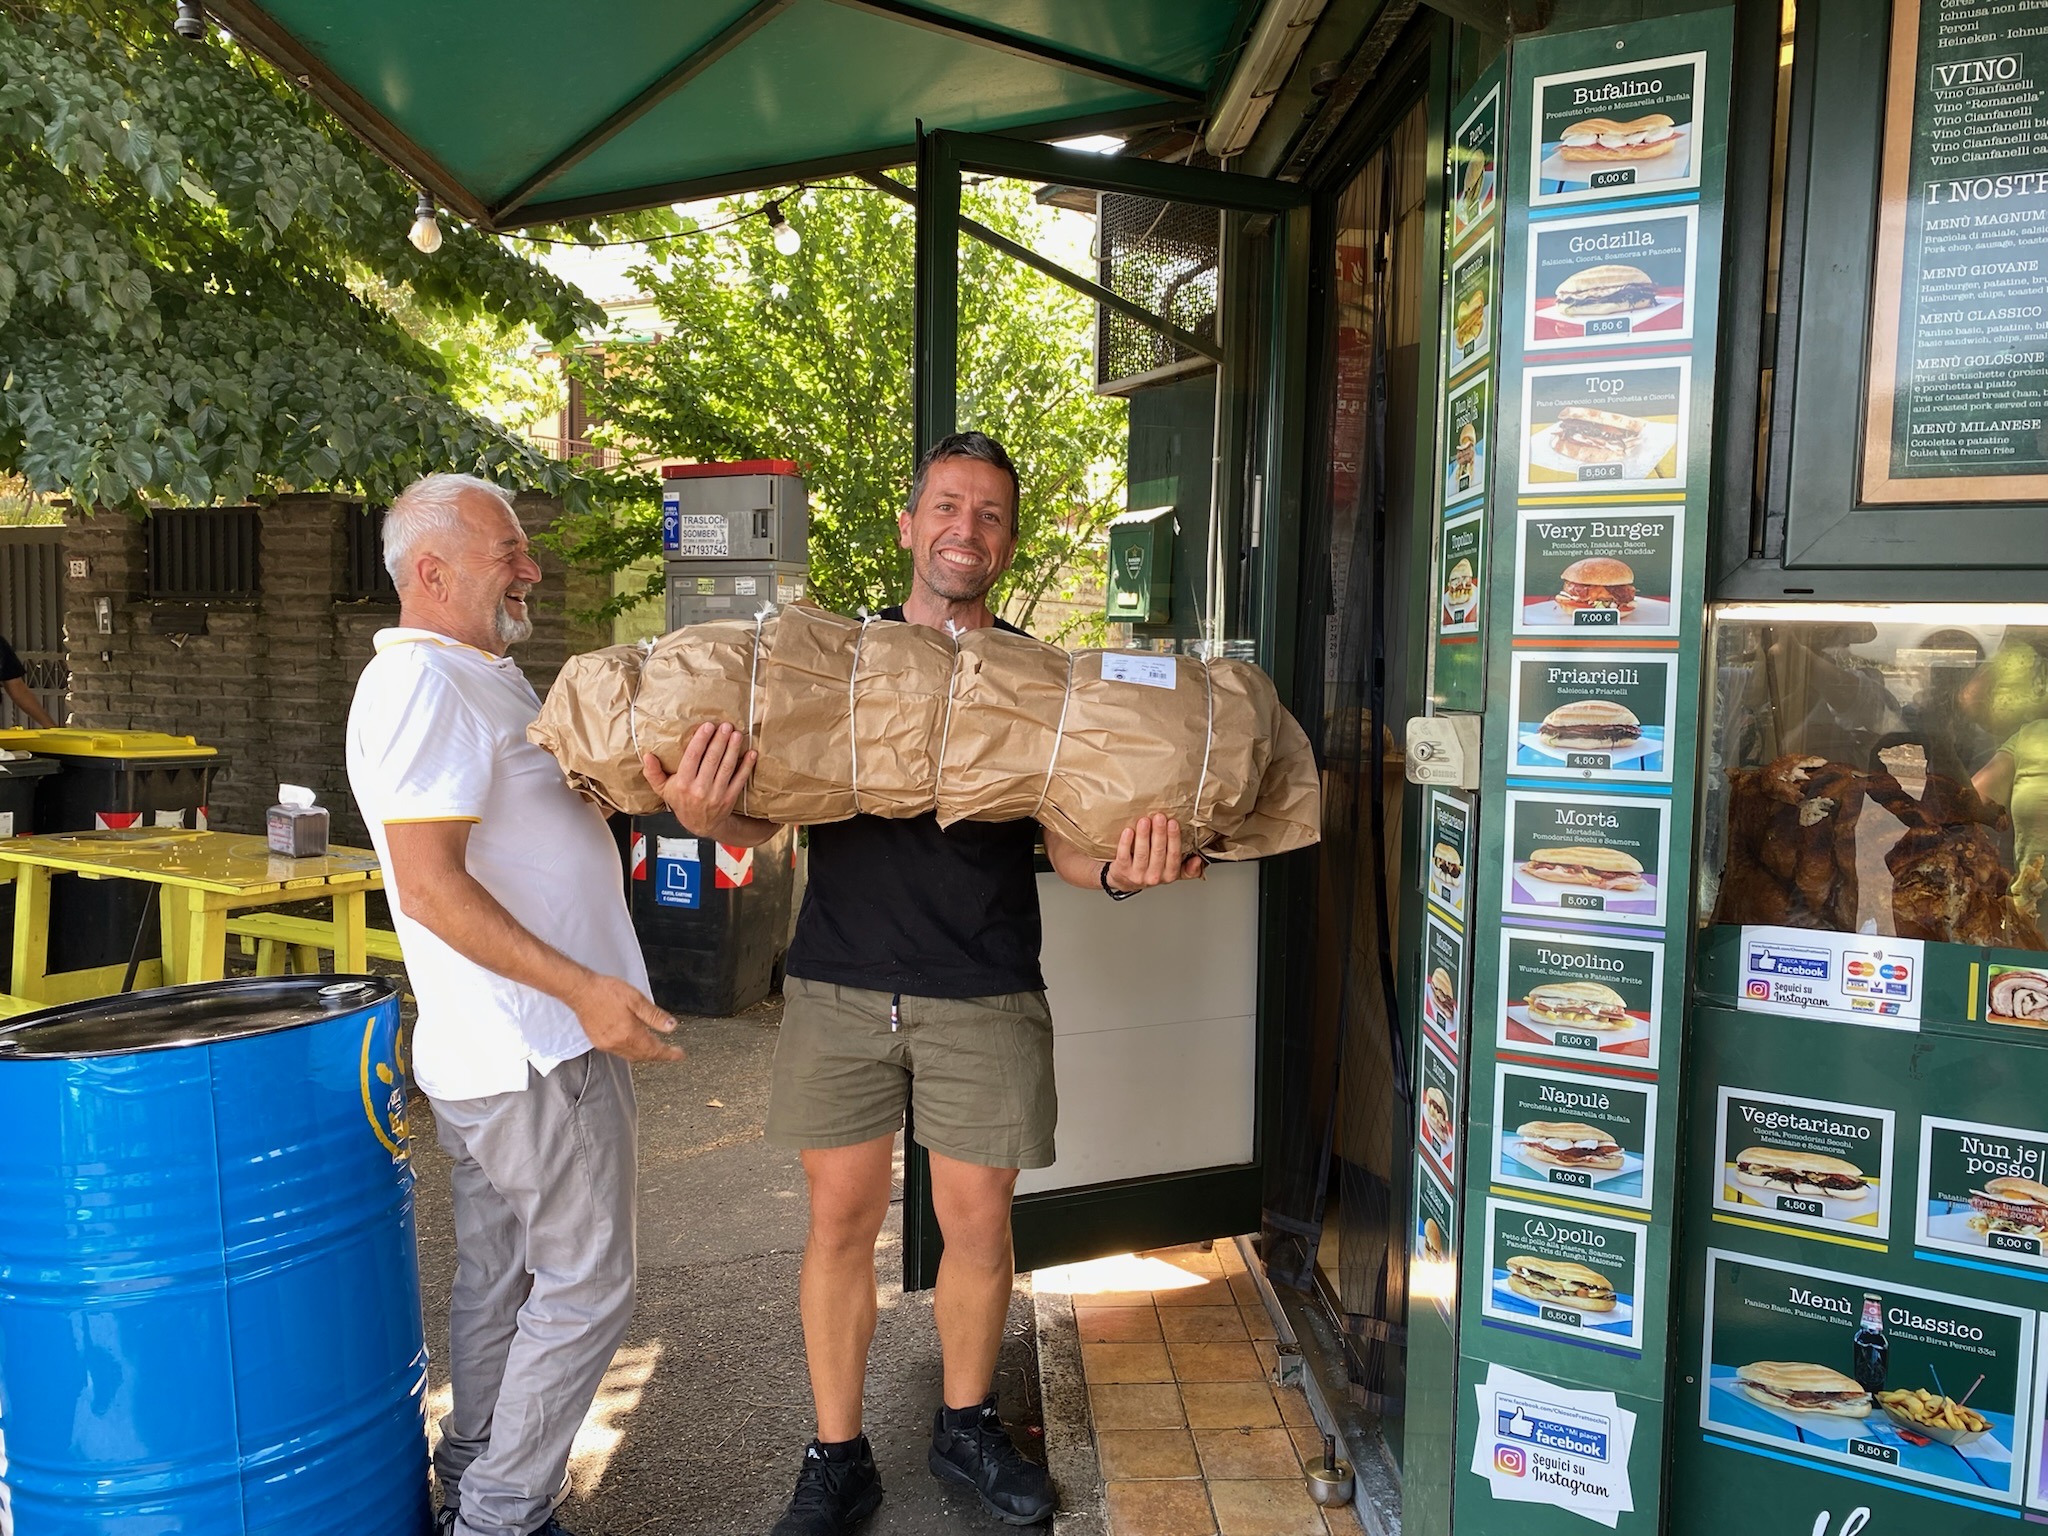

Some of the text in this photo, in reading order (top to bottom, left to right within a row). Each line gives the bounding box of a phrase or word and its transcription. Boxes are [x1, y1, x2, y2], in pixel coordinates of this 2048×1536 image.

[1940, 8, 1989, 22] Ichnusa
[1992, 5, 2015, 14] non
[1939, 21, 1979, 35] Peroni
[1938, 33, 1996, 48] Heineken
[1936, 57, 2017, 86] VINO
[1573, 80, 1662, 104] Bufalino
[1935, 80, 2033, 100] Vino Cianfanelli
[1546, 109, 1583, 119] Prosciutto
[1584, 105, 1606, 114] Crudo
[1614, 99, 1655, 110] Mozzarella
[1666, 93, 1690, 102] Bufala
[1935, 103, 1962, 113] Vino
[1934, 106, 2032, 126] Vino Cianfanelli
[1933, 120, 2031, 139] Vino Cianfanelli
[1932, 133, 2030, 152] Vino Cianfanelli
[1931, 146, 2029, 166] Vino Cianfanelli
[1622, 173, 1628, 181] €
[1928, 184, 1940, 204] I
[1926, 210, 2046, 231] MENÙ MAGNUM
[1569, 231, 1654, 252] Godzilla
[1925, 233, 1966, 244] Braciola
[1924, 246, 1945, 254] Pork
[1923, 260, 2038, 280] MENÙ GIOVANE
[1920, 306, 2042, 324] MENÙ CLASSICO
[1617, 321, 1622, 329] €
[1917, 352, 2044, 369] MENÙ GOLOSONE
[1586, 377, 1624, 394] Top
[1912, 419, 2041, 434] MENÙ MILANESE
[1911, 439, 1956, 447] Cotoletta
[1967, 437, 2009, 446] patatine
[1910, 448, 1938, 457] Cutlet
[1960, 447, 1990, 455] french
[1537, 523, 1664, 541] Very Burger
[683, 545, 727, 554] 3471937542
[1548, 668, 1639, 685] Friarielli
[1555, 809, 1619, 828] Morta
[1538, 949, 1624, 972] Topolino
[1519, 965, 1547, 975] Wurstel,
[1549, 969, 1583, 978] Scamorza
[1590, 973, 1620, 982] Patatine
[1621, 977, 1642, 985] Fritte
[1778, 963, 1824, 977] facebook
[1775, 982, 1802, 992] Seguici
[1774, 992, 1829, 1009] Instagram
[1584, 1038, 1590, 1046] €
[1540, 1085, 1610, 1109] Napulè
[1519, 1101, 1552, 1112] Porchetta
[1559, 1107, 1597, 1119] Mozzarella
[1607, 1114, 1630, 1123] Bufala
[1740, 1106, 1870, 1140] Vegetariano
[1753, 1127, 1853, 1149] Cicoria, Pomodorini Secchi,
[1761, 1136, 1800, 1148] Melanzane
[1808, 1143, 1845, 1154] Scamorza
[1960, 1136, 2037, 1164] Nun je
[1966, 1157, 2034, 1179] posso
[1578, 1175, 1584, 1183] €
[1809, 1204, 1815, 1212] €
[1525, 1219, 1606, 1247] (A)pollo
[2024, 1242, 2032, 1250] €
[1569, 1314, 1575, 1322] €
[1744, 1299, 1770, 1309] Panino
[1771, 1304, 1793, 1315] Basic,
[1795, 1309, 1828, 1322] Patatine,
[1830, 1316, 1853, 1327] Bibita
[1789, 1287, 1983, 1340] Menù Classico
[1889, 1328, 1918, 1340] Lattina
[1926, 1336, 1948, 1347] Birra
[1949, 1341, 1976, 1352] Peroni
[1977, 1347, 1996, 1357] 33cl
[1539, 1422, 1564, 1433] CLICCA
[1536, 1430, 1601, 1457] facebook
[1883, 1450, 1890, 1458] €
[1533, 1452, 1585, 1475] Seguici su
[1532, 1466, 1609, 1497] Instagram
